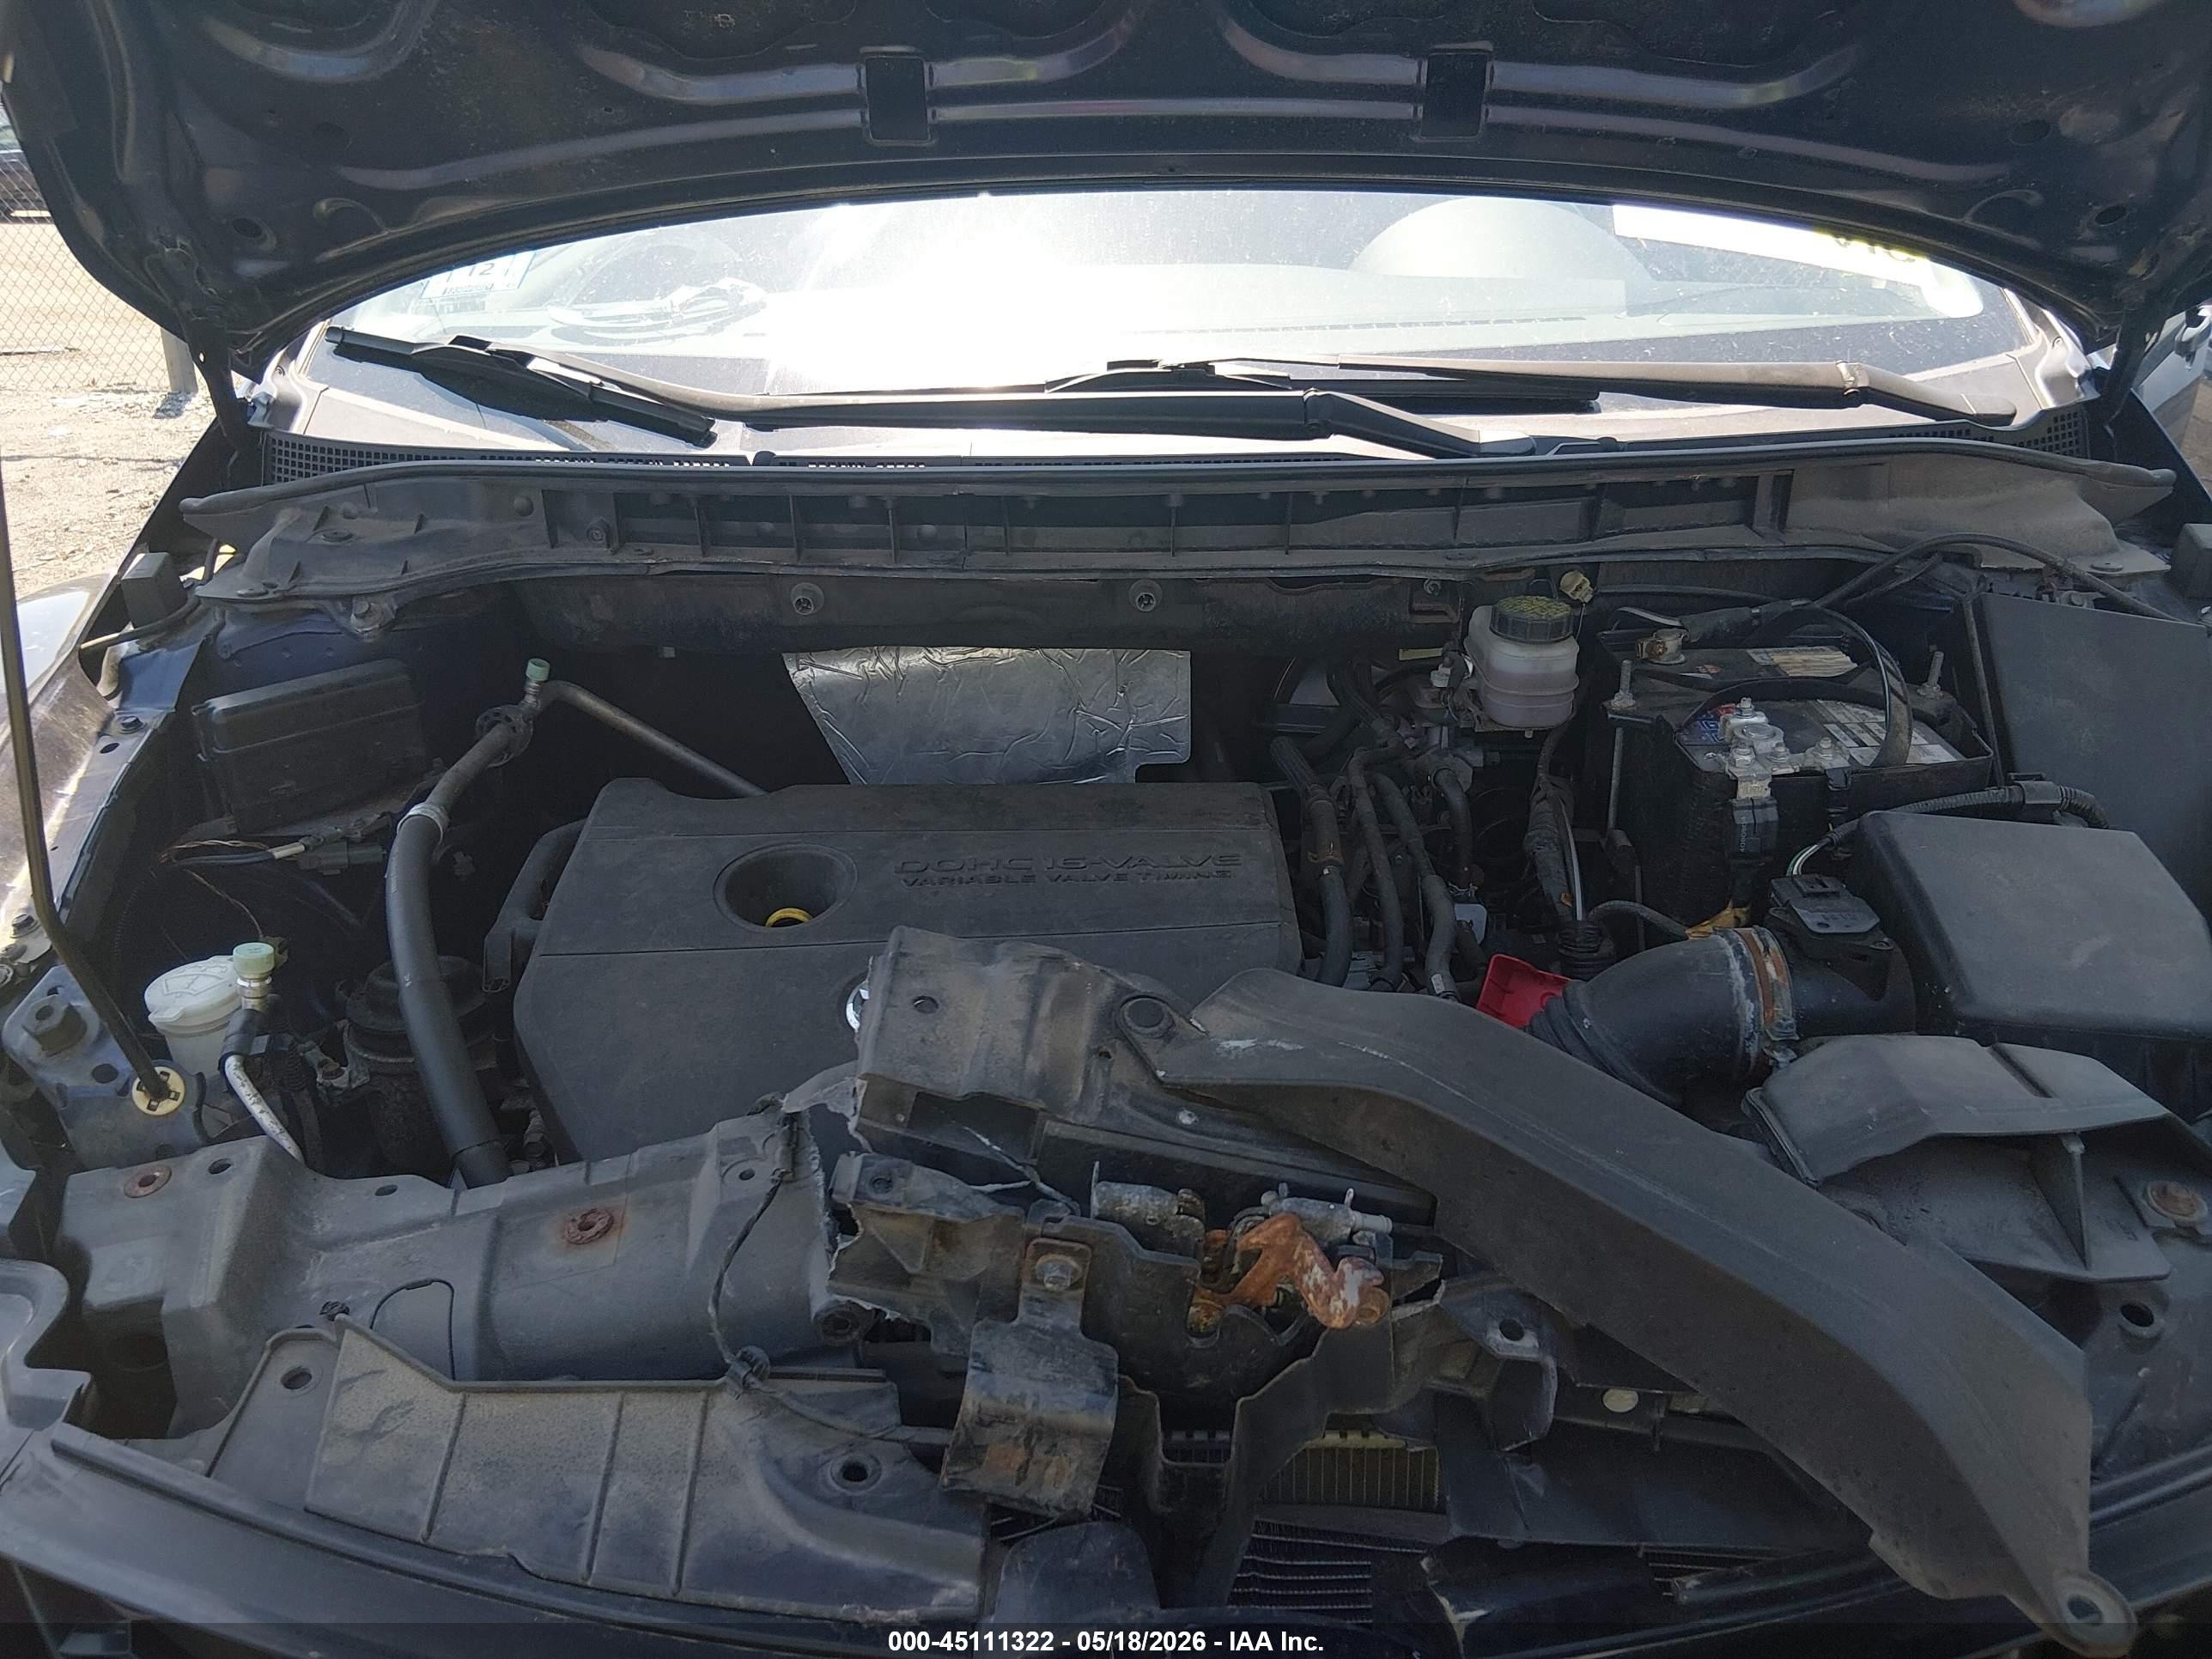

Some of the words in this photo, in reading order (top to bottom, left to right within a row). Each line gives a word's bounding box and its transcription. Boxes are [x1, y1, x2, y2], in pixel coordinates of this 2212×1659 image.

[894, 857, 1034, 875] DOHC
[1045, 854, 1243, 870] 16-VALVE
[903, 874, 1037, 888] VARIABLE
[1046, 872, 1128, 884] VALVE
[1136, 869, 1232, 882] TIMING
